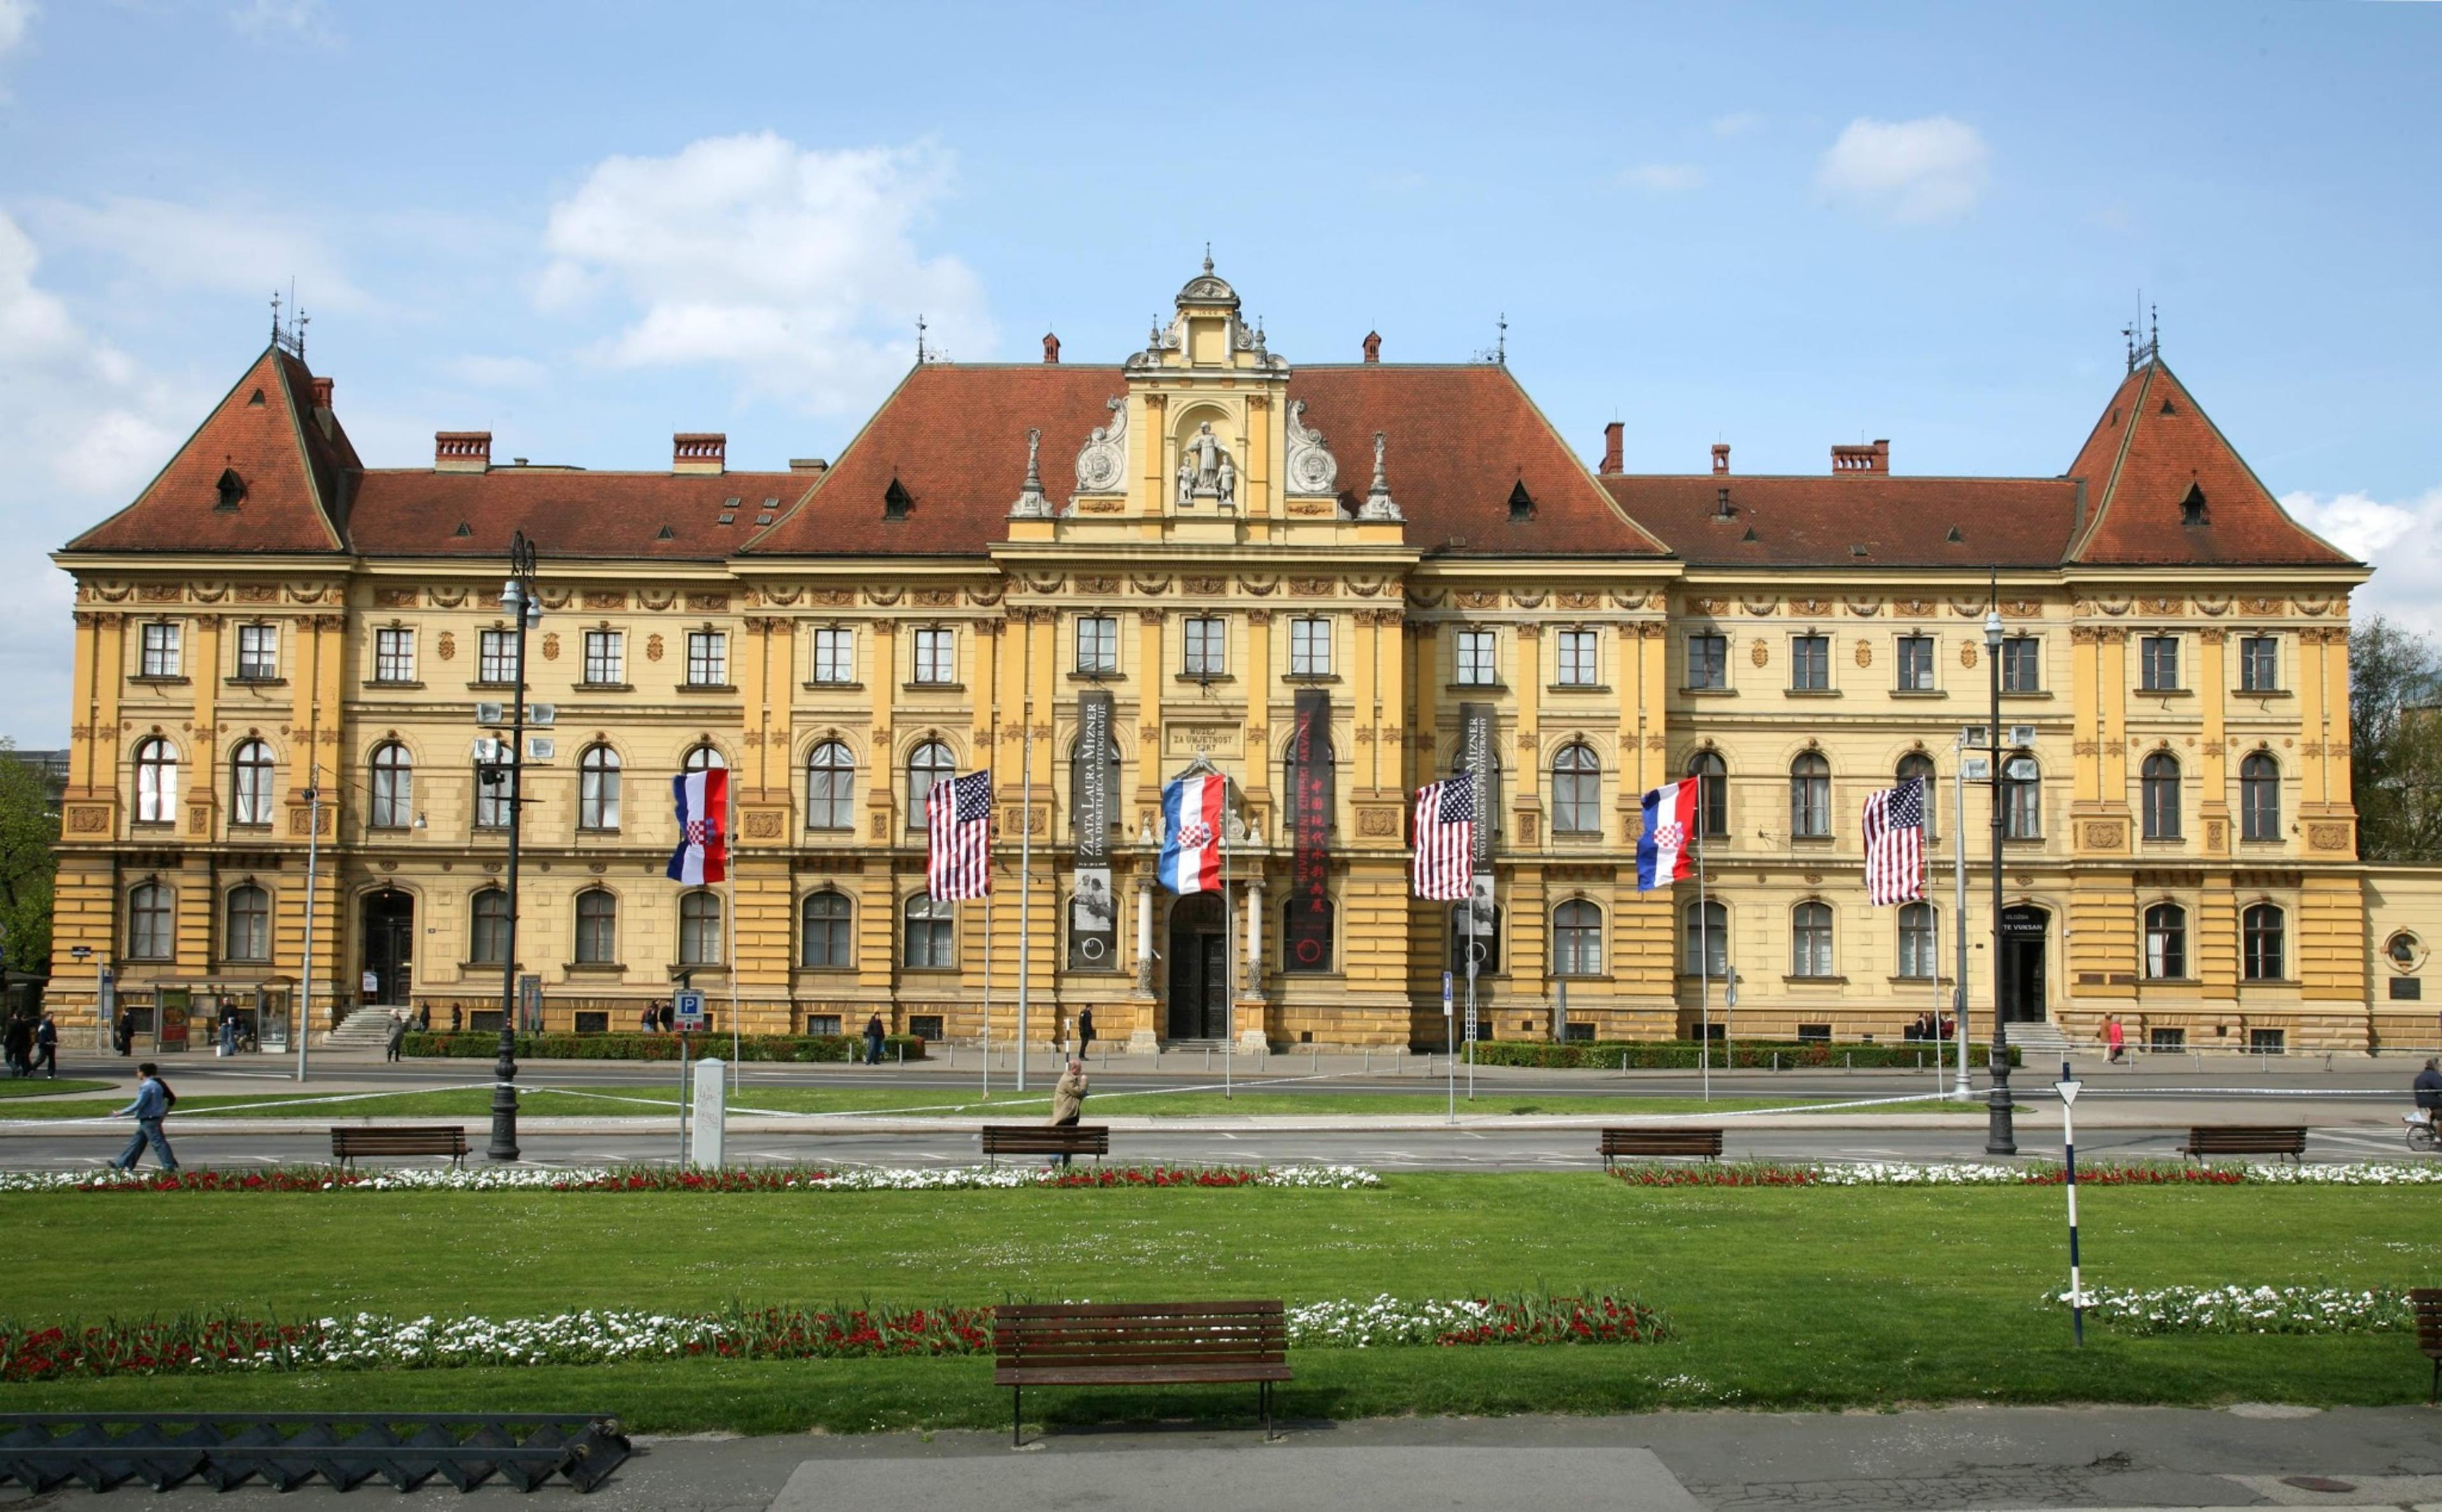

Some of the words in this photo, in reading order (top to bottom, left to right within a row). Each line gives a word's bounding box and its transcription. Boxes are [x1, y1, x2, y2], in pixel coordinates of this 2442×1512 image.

[1096, 704, 1107, 770] FOTOGRAFIJE
[1094, 773, 1105, 834] DESETLJEĆA
[1298, 767, 1309, 810] KINESKI
[1479, 784, 1486, 797] OF
[1297, 815, 1309, 882] SUVREMENI
[685, 998, 695, 1012] P
